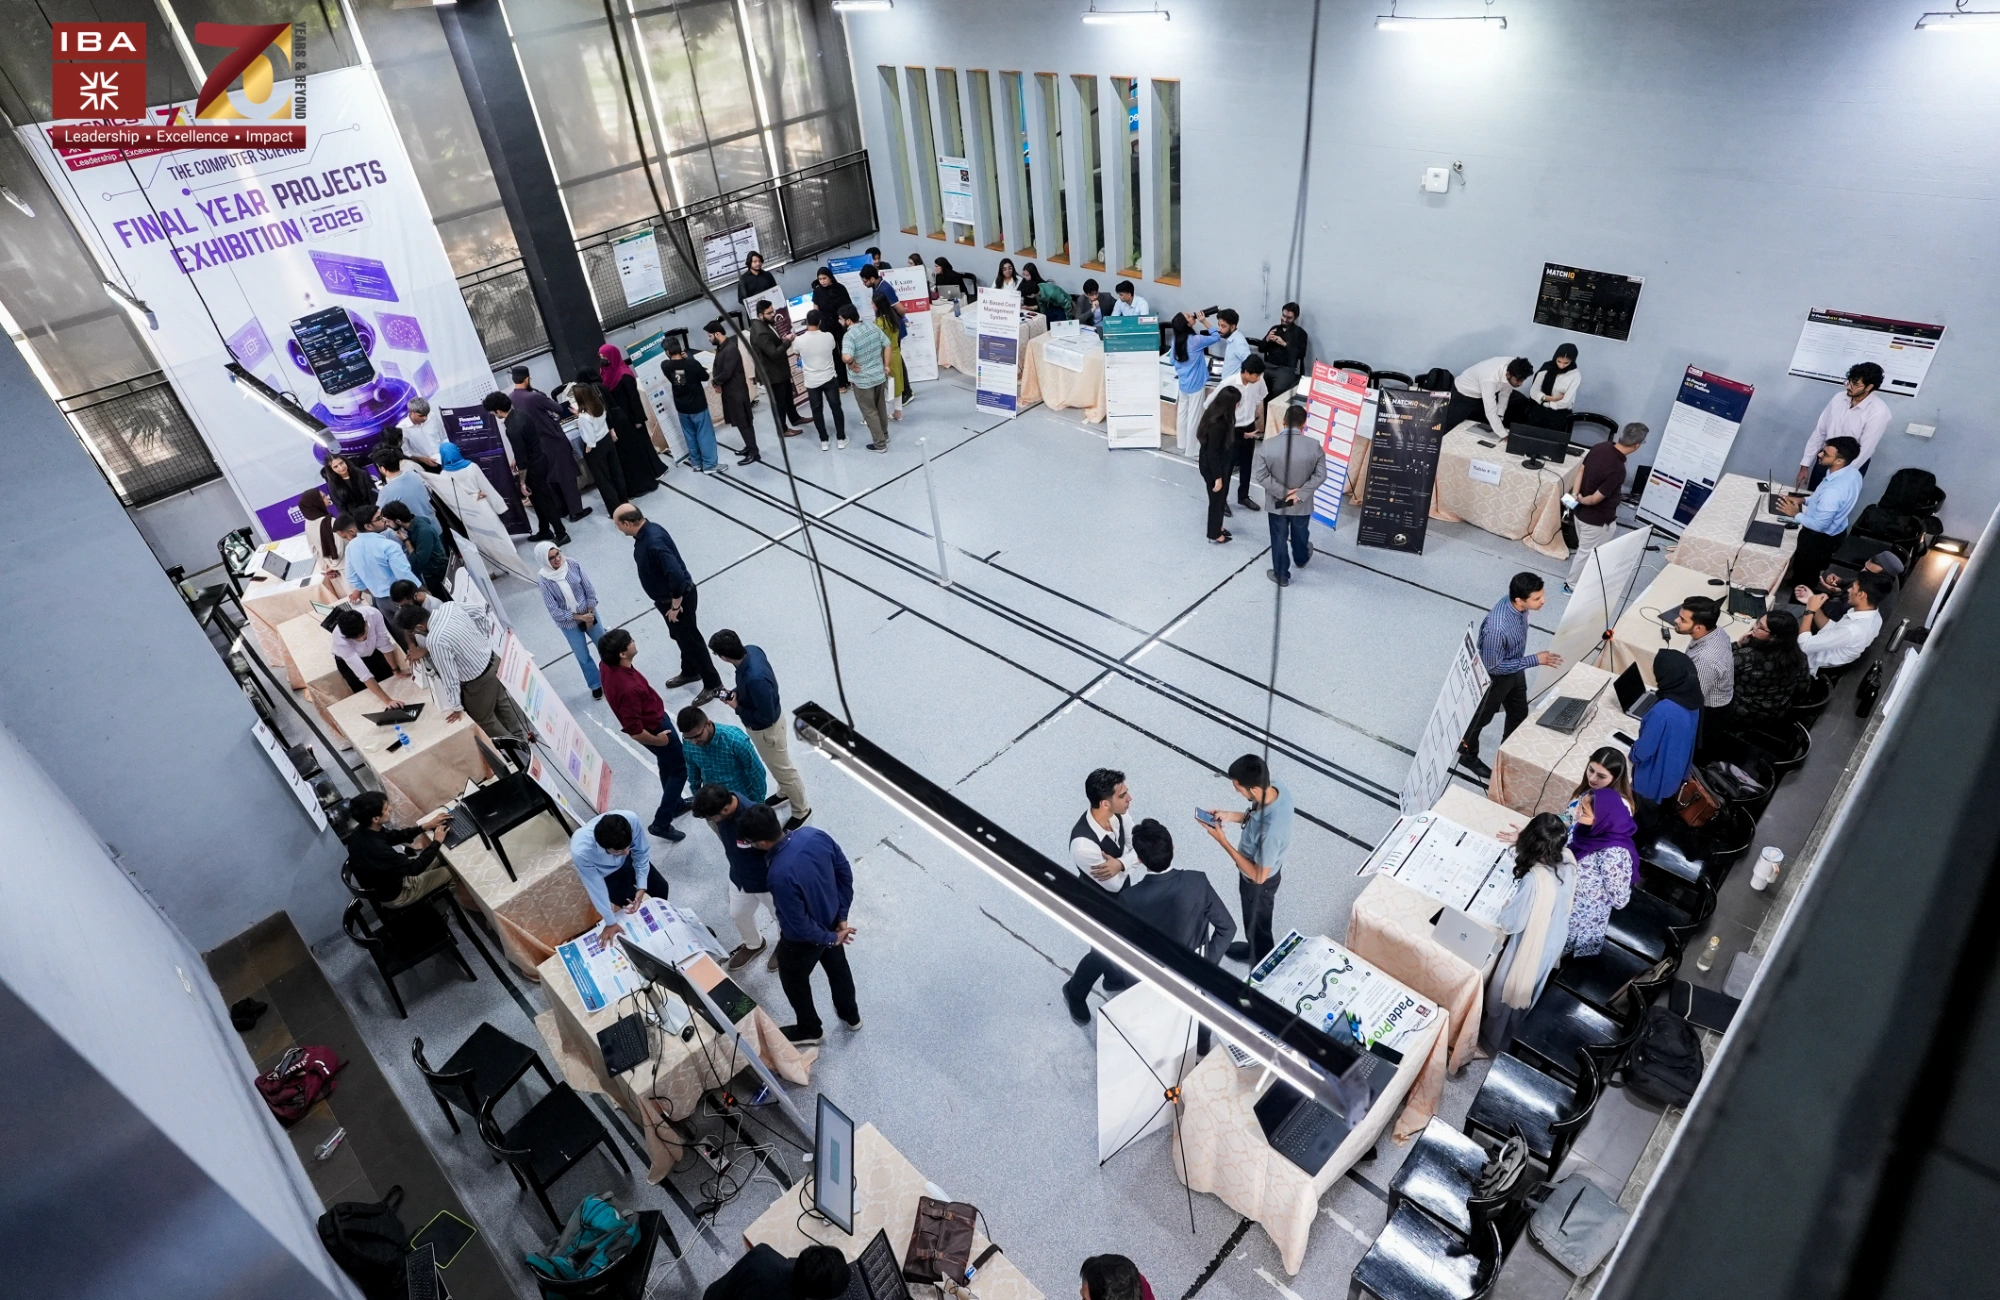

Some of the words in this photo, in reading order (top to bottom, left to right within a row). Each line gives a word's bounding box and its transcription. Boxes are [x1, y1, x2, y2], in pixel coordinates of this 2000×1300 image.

[74, 153, 117, 167] Leadership
[167, 163, 195, 181] THE
[194, 149, 258, 175] COMPUTER
[257, 149, 305, 161] SCIEN
[113, 208, 199, 248] FINAL
[196, 188, 270, 227] YEAR
[271, 159, 387, 209] PROJECTS
[170, 218, 304, 274] EXHIBITION
[308, 206, 364, 234] 2026
[983, 306, 1014, 314] Management
[990, 313, 1008, 321] System
[1374, 995, 1415, 1038] PadelPro
